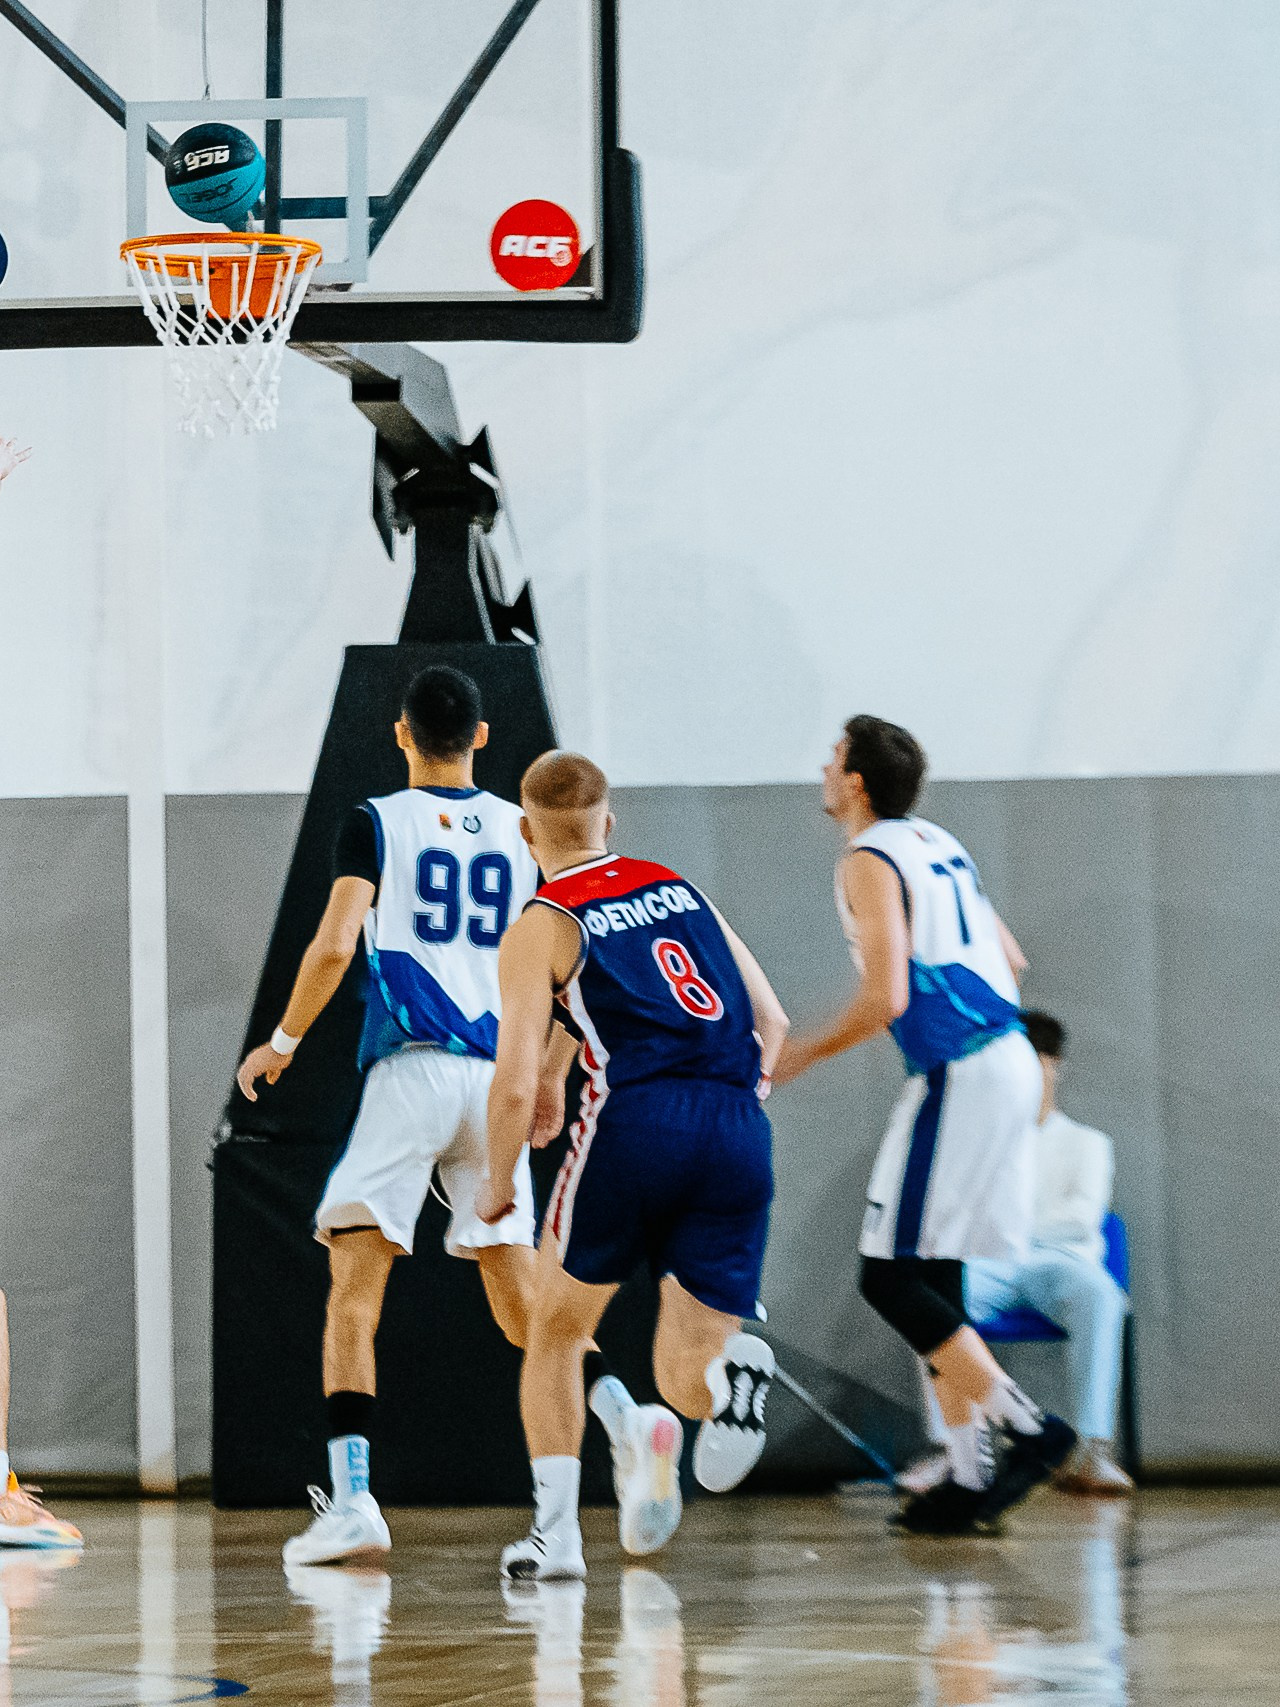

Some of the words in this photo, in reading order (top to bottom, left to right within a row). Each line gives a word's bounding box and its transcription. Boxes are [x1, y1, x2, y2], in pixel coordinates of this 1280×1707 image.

[498, 234, 573, 267] АСБ
[413, 848, 513, 950] 99
[584, 885, 701, 938] ФЕТИСОВ
[651, 938, 724, 1021] 8
